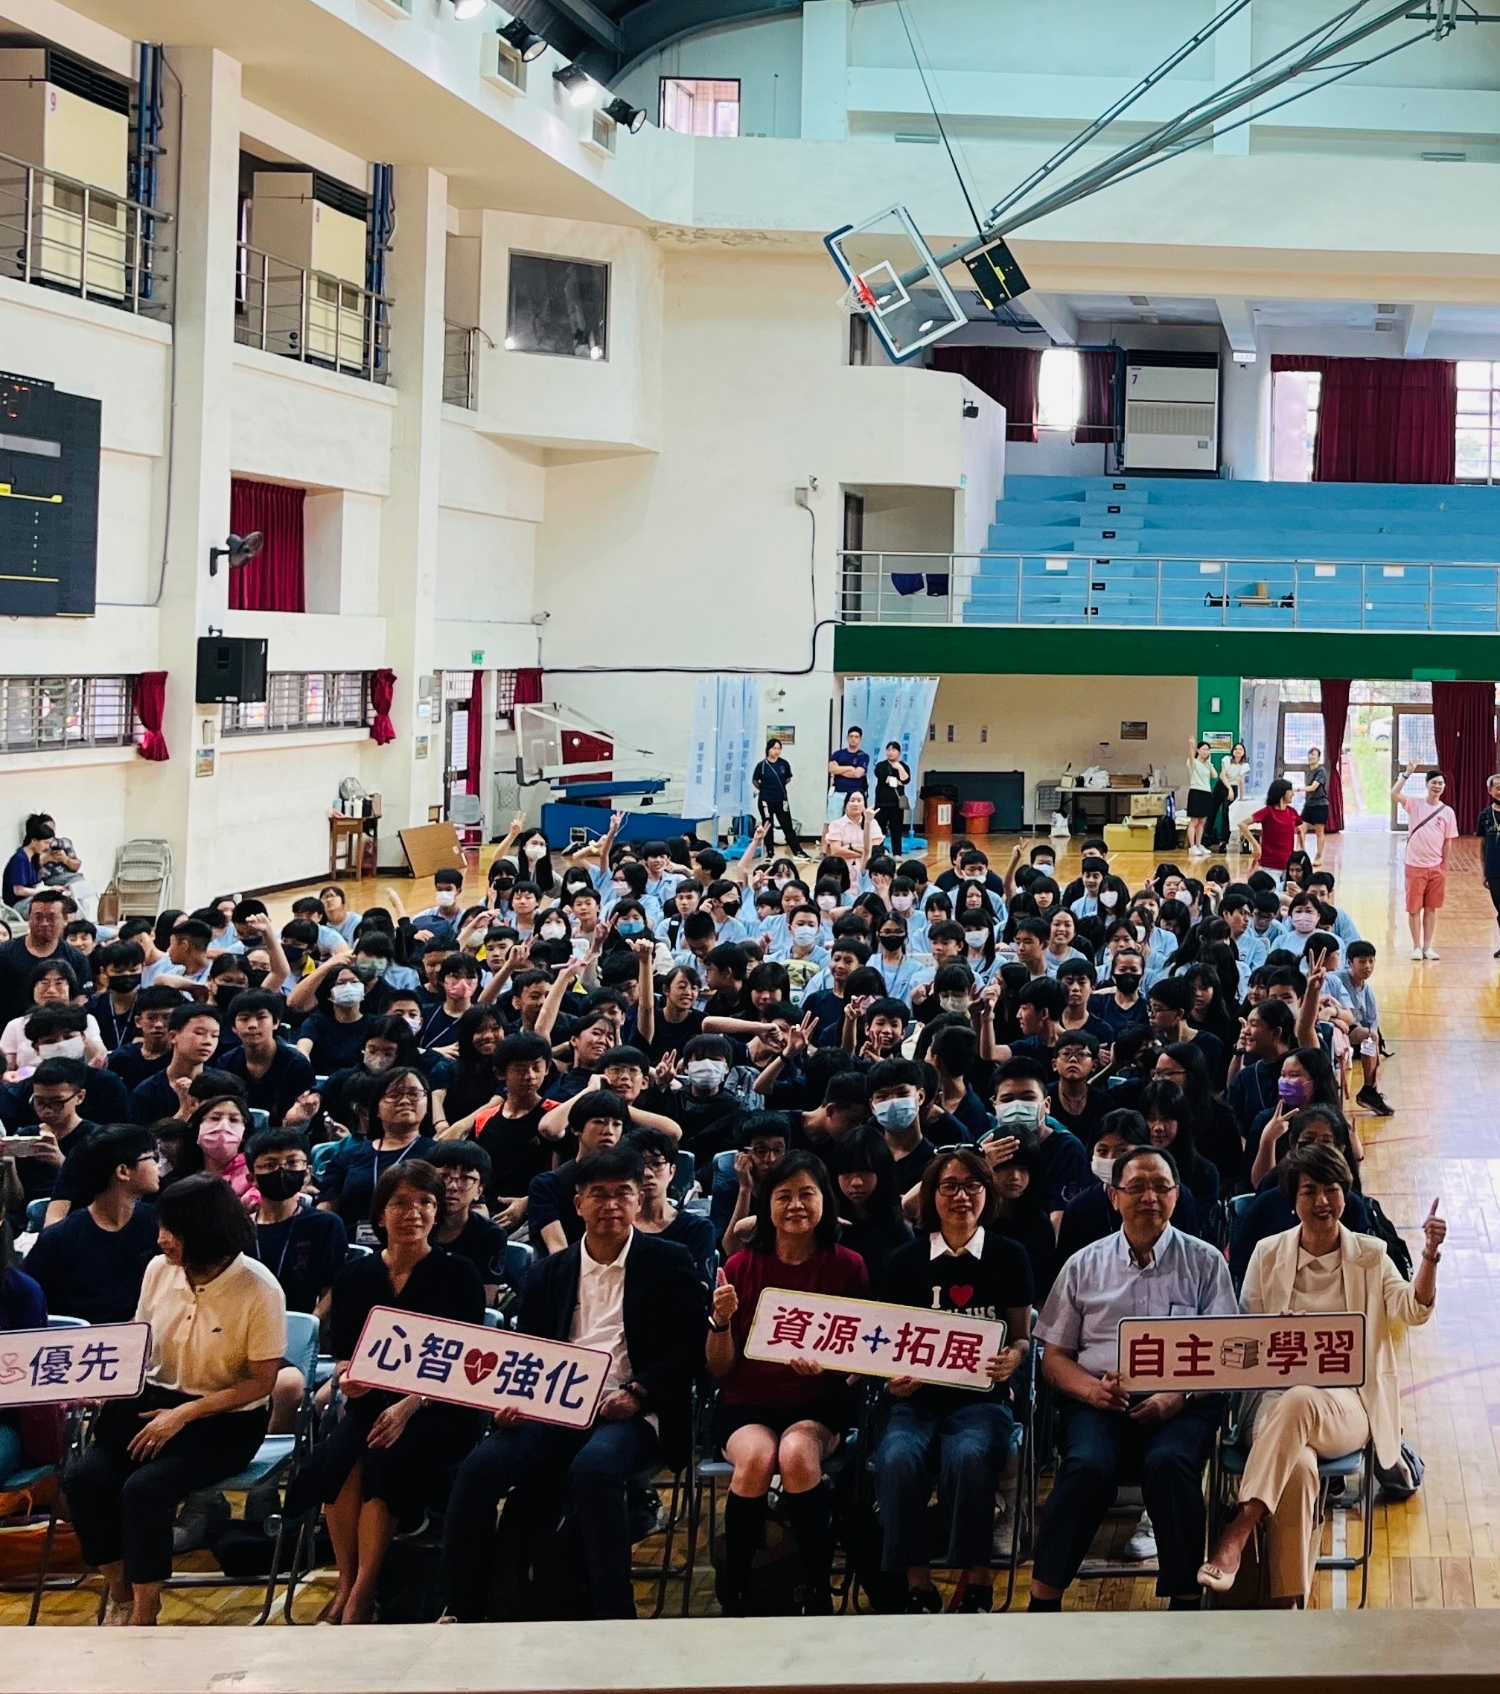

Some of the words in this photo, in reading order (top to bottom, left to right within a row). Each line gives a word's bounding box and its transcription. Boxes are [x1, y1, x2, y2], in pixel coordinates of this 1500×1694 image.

[1132, 374, 1138, 385] 7
[931, 1286, 942, 1309] I
[767, 1306, 858, 1355] 資源
[894, 1321, 982, 1374] 拓展
[1129, 1332, 1216, 1379] 自主
[1266, 1329, 1355, 1375] 學習
[29, 1342, 120, 1387] 優先
[368, 1325, 465, 1380] 心智
[494, 1350, 589, 1410] 強化
